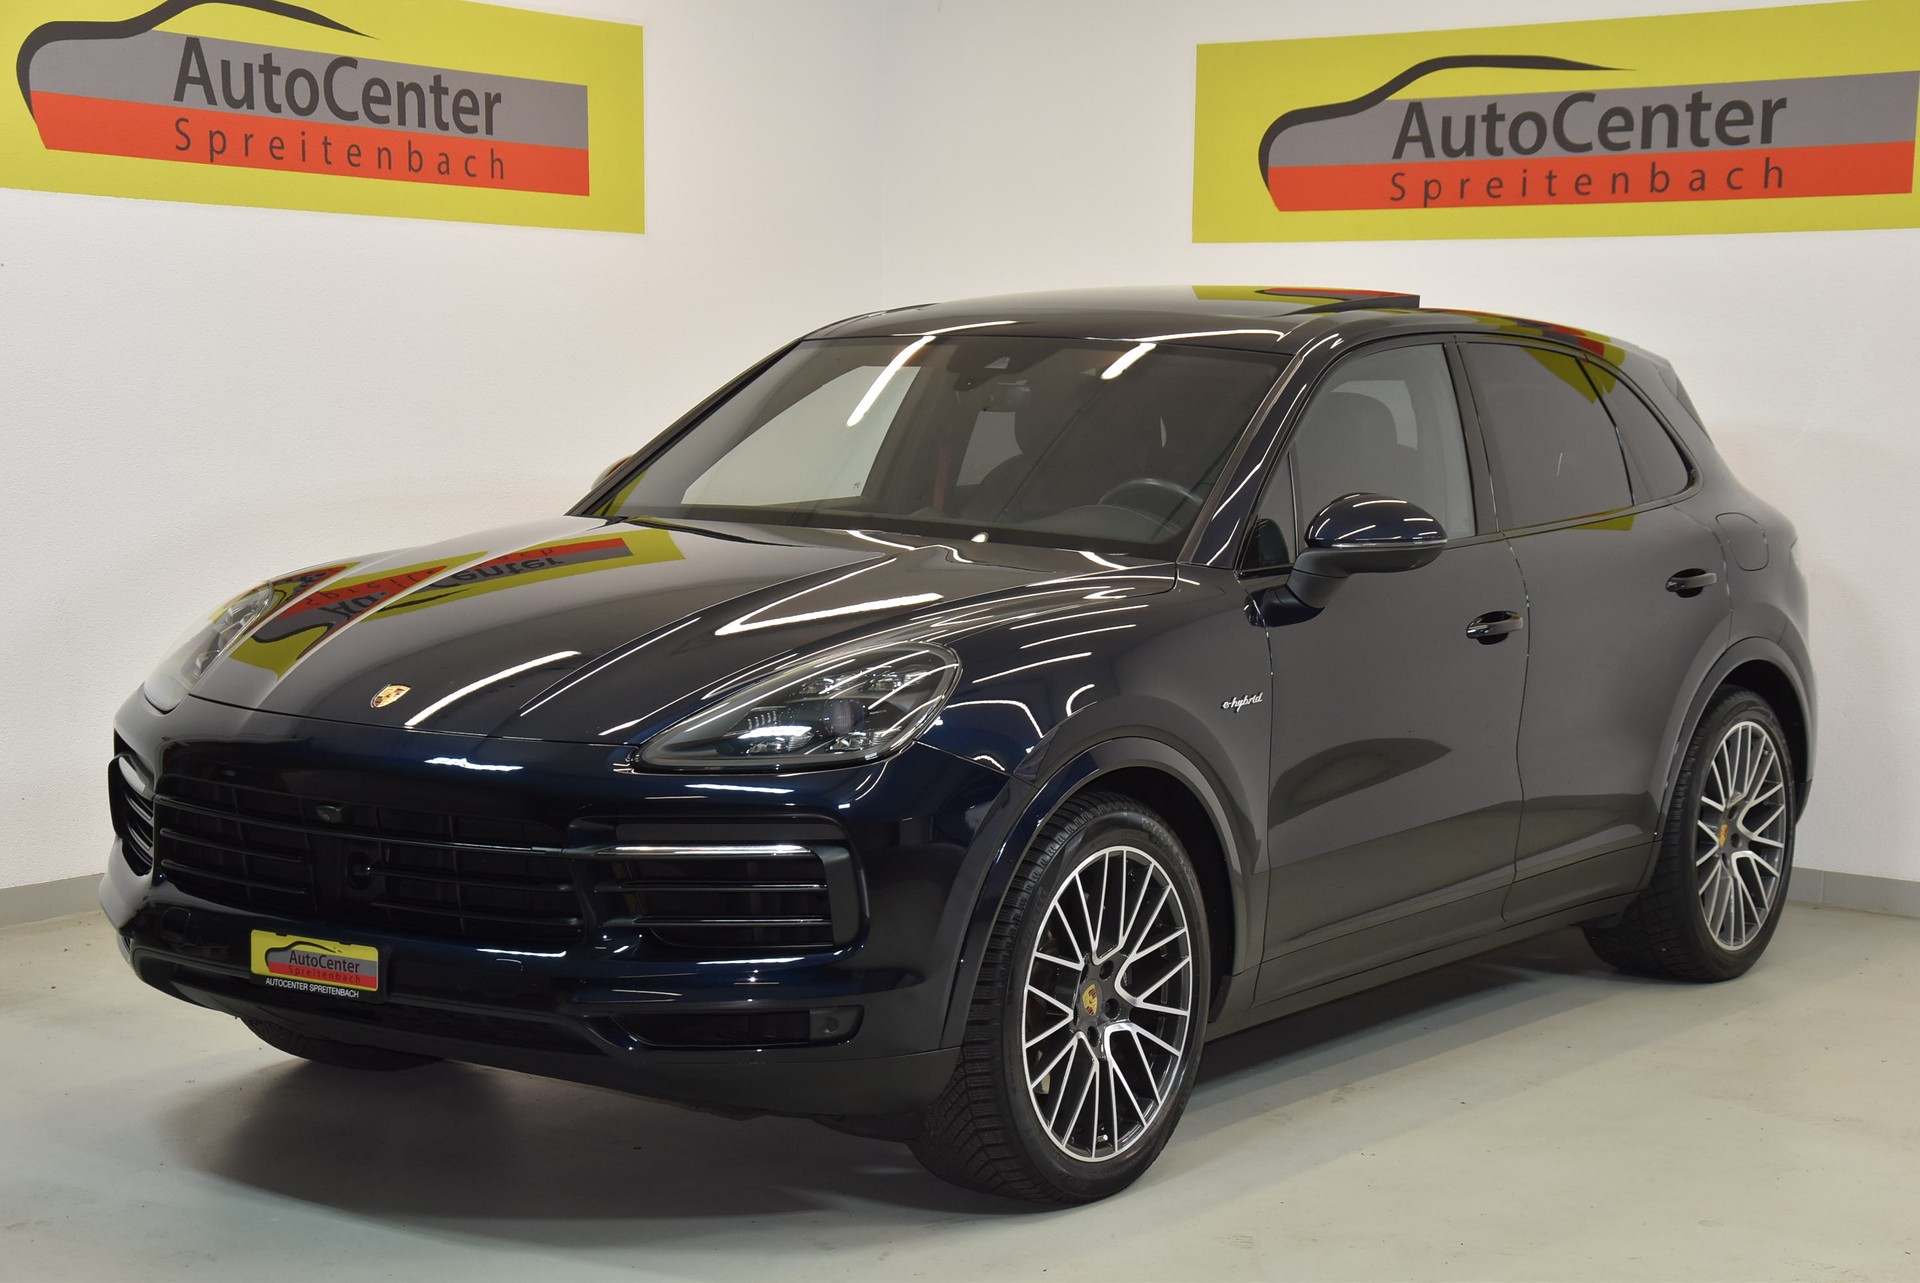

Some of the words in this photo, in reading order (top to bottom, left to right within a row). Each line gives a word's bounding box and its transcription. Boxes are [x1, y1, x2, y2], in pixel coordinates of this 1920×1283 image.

[173, 36, 502, 136] AutoCenter
[175, 117, 505, 180] Spreitenbach
[1391, 90, 1788, 160] AutoCenter
[1389, 157, 1784, 207] Spreitenbach
[288, 965, 361, 984] Spreitenbach
[289, 950, 360, 973] AutoCenter
[265, 977, 308, 991] AUTOCENTER
[309, 984, 360, 998] SPREITENBACH
